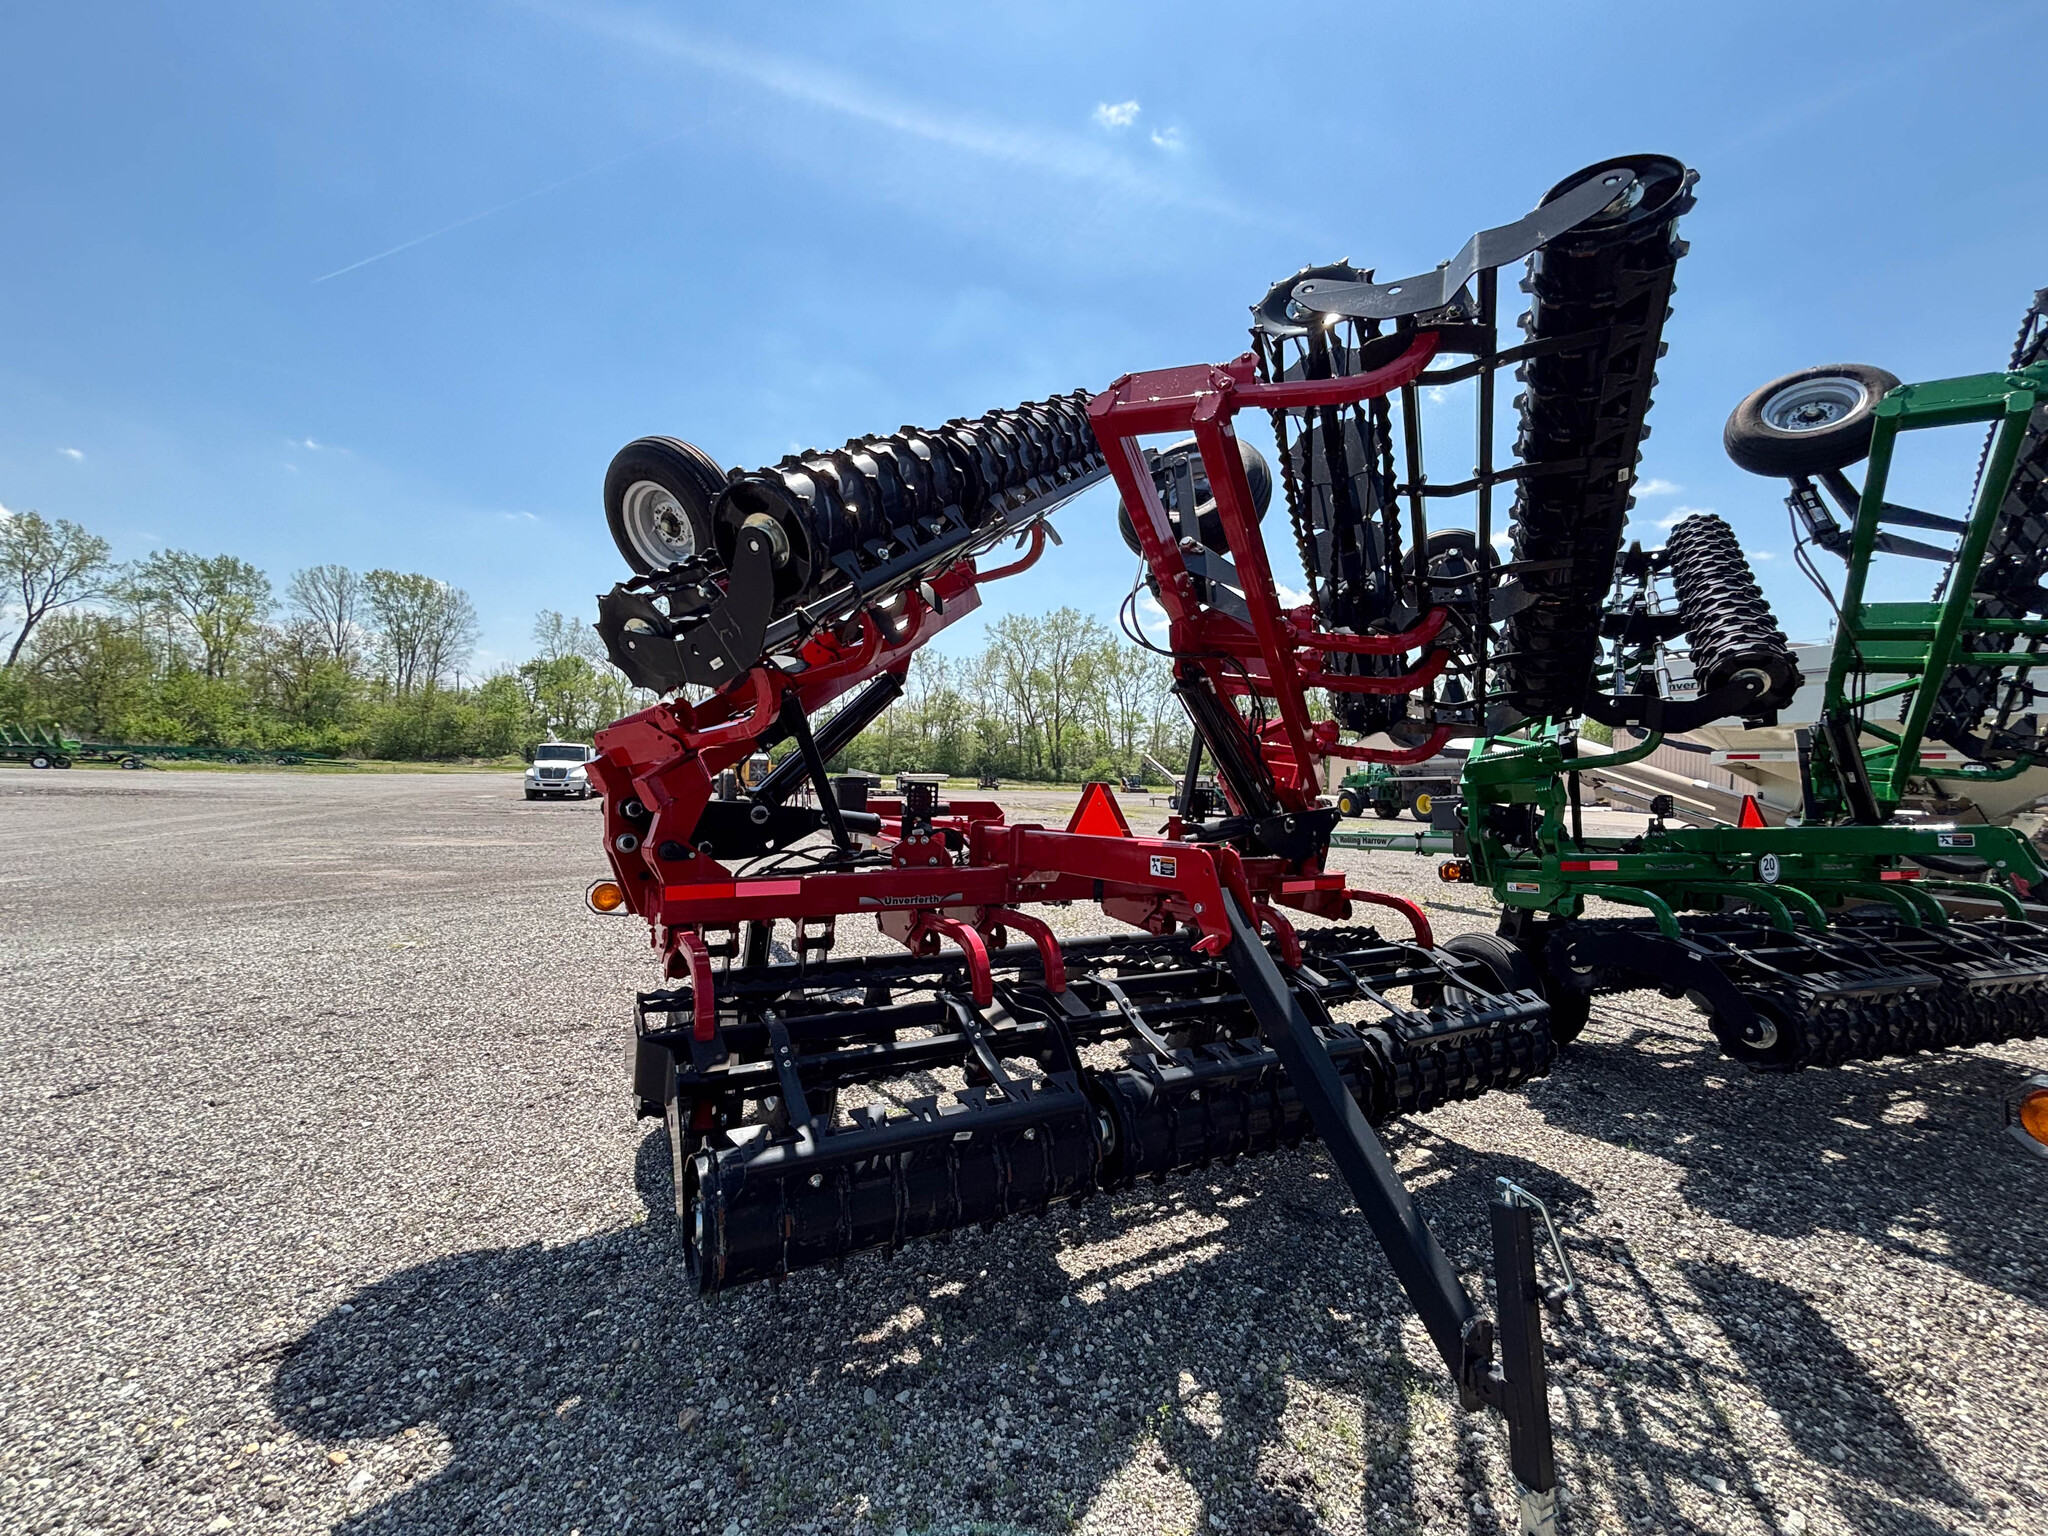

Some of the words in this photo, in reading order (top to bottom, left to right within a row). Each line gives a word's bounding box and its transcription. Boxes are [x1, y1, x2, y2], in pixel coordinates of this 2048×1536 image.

[1339, 836, 1361, 846] Rolling
[1362, 836, 1387, 845] Harrow
[1763, 858, 1775, 870] 20
[884, 895, 940, 905] Unverferth
